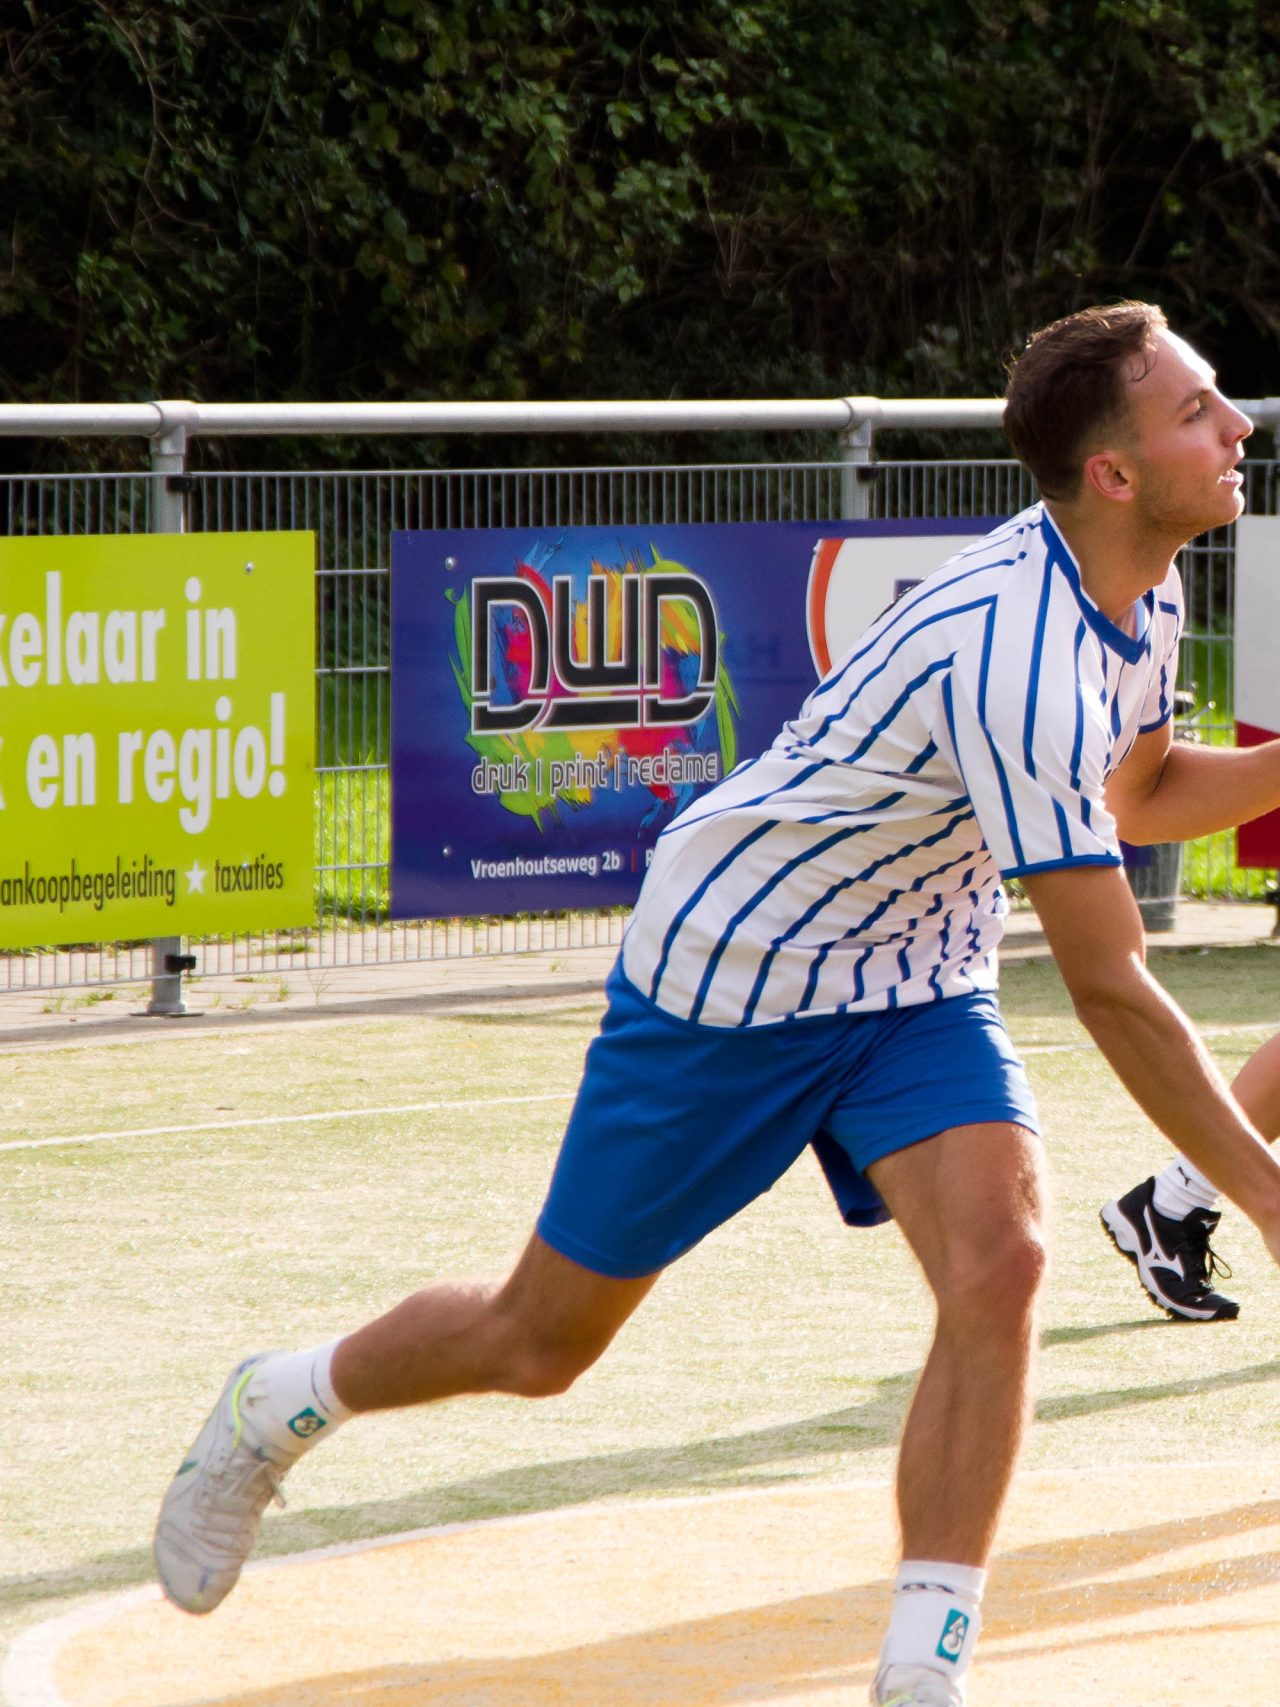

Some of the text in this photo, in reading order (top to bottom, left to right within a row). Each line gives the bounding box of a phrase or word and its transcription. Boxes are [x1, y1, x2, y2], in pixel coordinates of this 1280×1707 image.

[185, 576, 237, 680] in
[471, 573, 719, 735] DWD
[26, 732, 97, 809] en
[118, 692, 286, 834] regio!
[471, 746, 718, 797] druk print reclame
[0, 853, 284, 913] ankoopbegeleiding taxaties
[470, 857, 598, 880] Vroenhoutseweg
[602, 850, 621, 871] 2b
